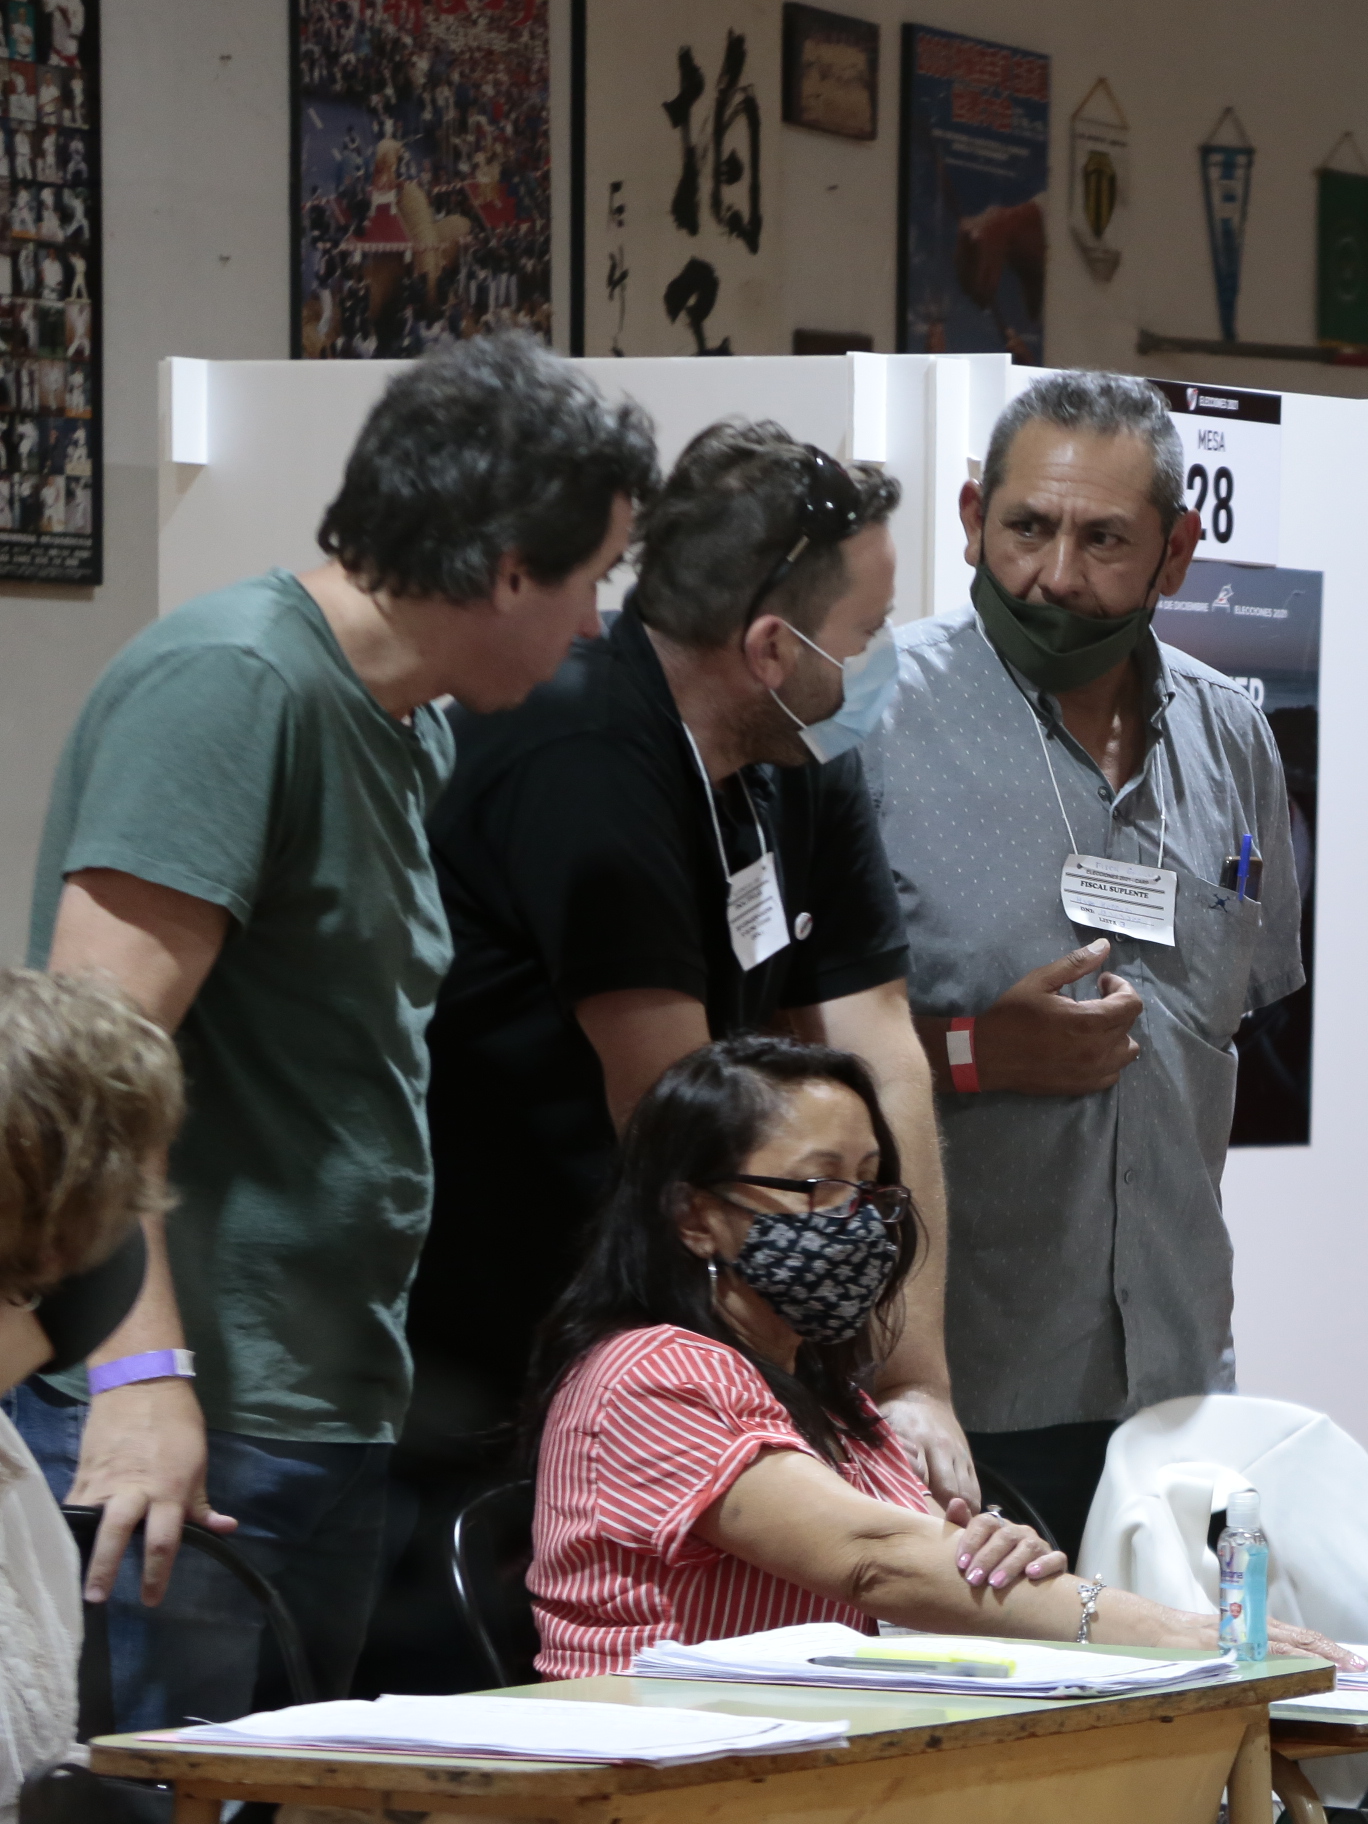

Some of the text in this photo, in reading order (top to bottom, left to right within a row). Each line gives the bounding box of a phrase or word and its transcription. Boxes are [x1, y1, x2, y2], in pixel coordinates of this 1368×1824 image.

[1198, 429, 1225, 452] MESA
[1187, 463, 1234, 543] 28
[1234, 605, 1272, 617] ELECCIONES
[1086, 869, 1118, 880] ELECCIONES
[1080, 880, 1149, 899] FISCAL SUPLENTE
